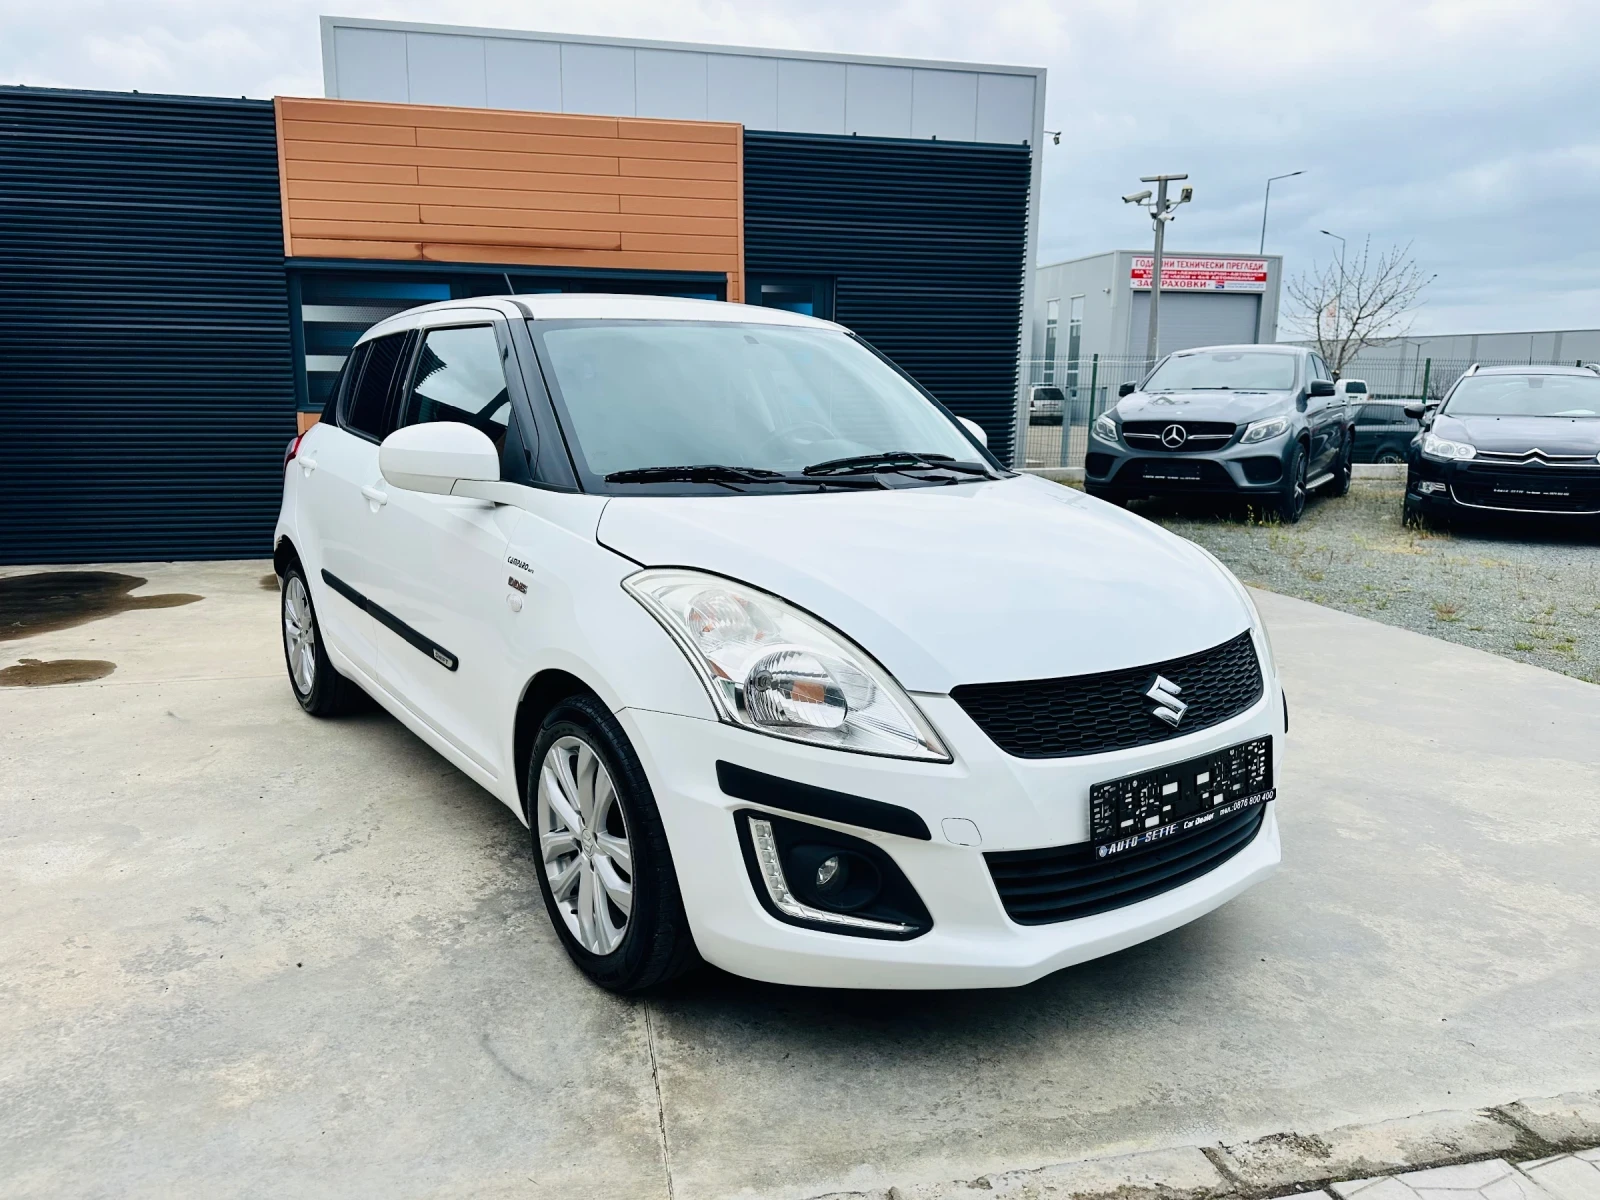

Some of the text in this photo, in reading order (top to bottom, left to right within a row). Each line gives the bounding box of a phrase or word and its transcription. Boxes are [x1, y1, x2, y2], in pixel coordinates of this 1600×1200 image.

[1135, 259, 1264, 271] ГОДИНИ ТЕХНИЧЕСКИ ПРЕГЛЕДИ
[1136, 279, 1207, 288] ЗАСРАХОВКИ
[1108, 836, 1139, 855] AUTO
[1144, 823, 1177, 843] SETTE
[1183, 820, 1195, 830] Car
[1194, 812, 1215, 826] Dealer
[1261, 790, 1274, 801] 400
